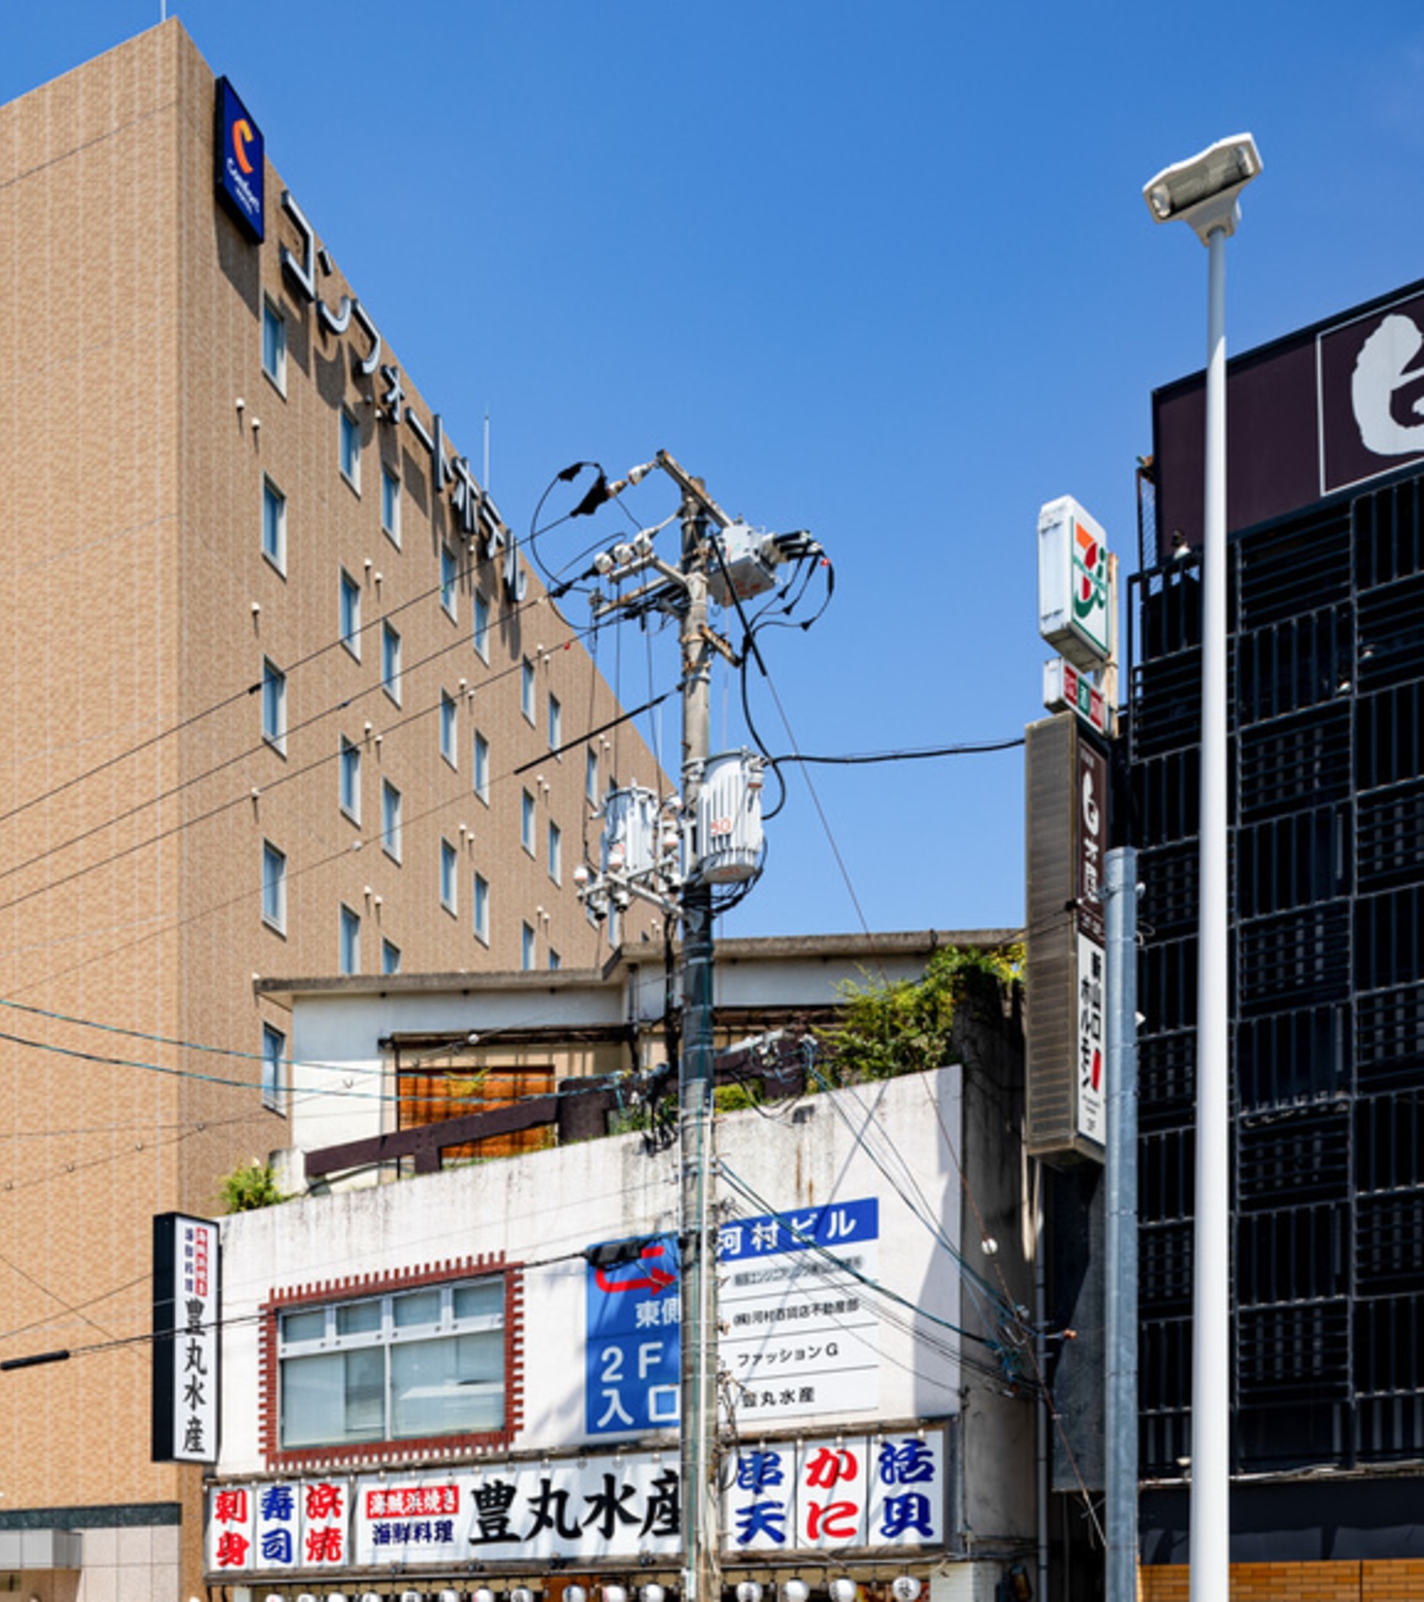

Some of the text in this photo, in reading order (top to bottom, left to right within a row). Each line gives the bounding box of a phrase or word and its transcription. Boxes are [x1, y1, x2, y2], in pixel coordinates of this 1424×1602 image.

[281, 190, 527, 602] コンフォートホテル
[716, 1210, 856, 1257] 河村ビル
[183, 1298, 207, 1454] 豊丸水産
[601, 1342, 664, 1383] 2F
[597, 1384, 681, 1429] 入口
[215, 1488, 250, 1567] 刺身
[261, 1486, 294, 1564] 寿司
[469, 1468, 680, 1545] 豊丸水産
[735, 1451, 786, 1545] 串天
[806, 1447, 858, 1540] かに
[878, 1438, 936, 1539] 活貝
